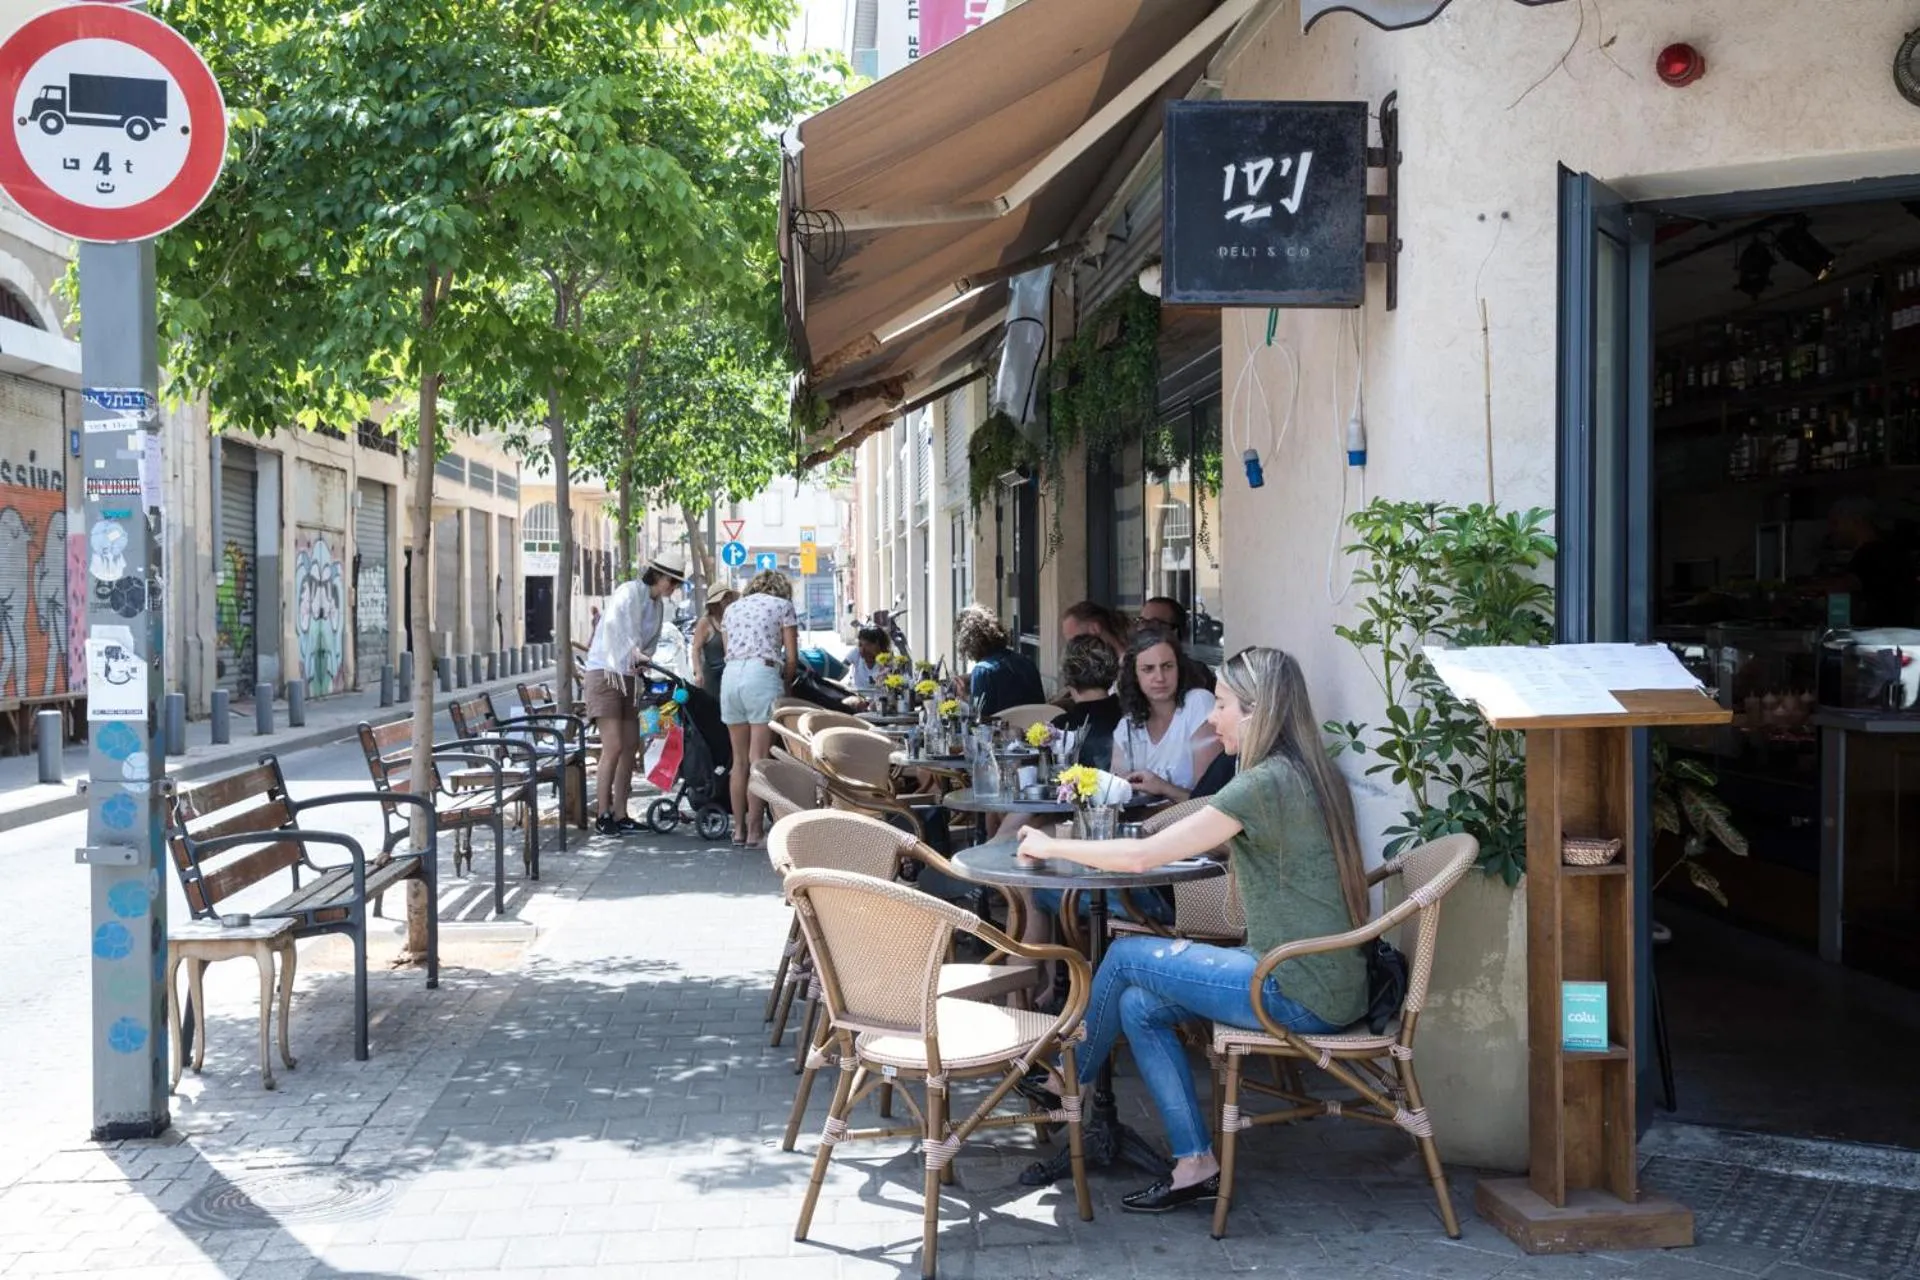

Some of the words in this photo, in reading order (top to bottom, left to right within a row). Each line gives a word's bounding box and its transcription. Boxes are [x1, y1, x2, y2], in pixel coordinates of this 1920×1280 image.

[93, 152, 112, 175] 4
[124, 160, 134, 173] t
[1219, 246, 1257, 257] DELI
[1267, 246, 1278, 257] &
[1286, 246, 1311, 257] CO
